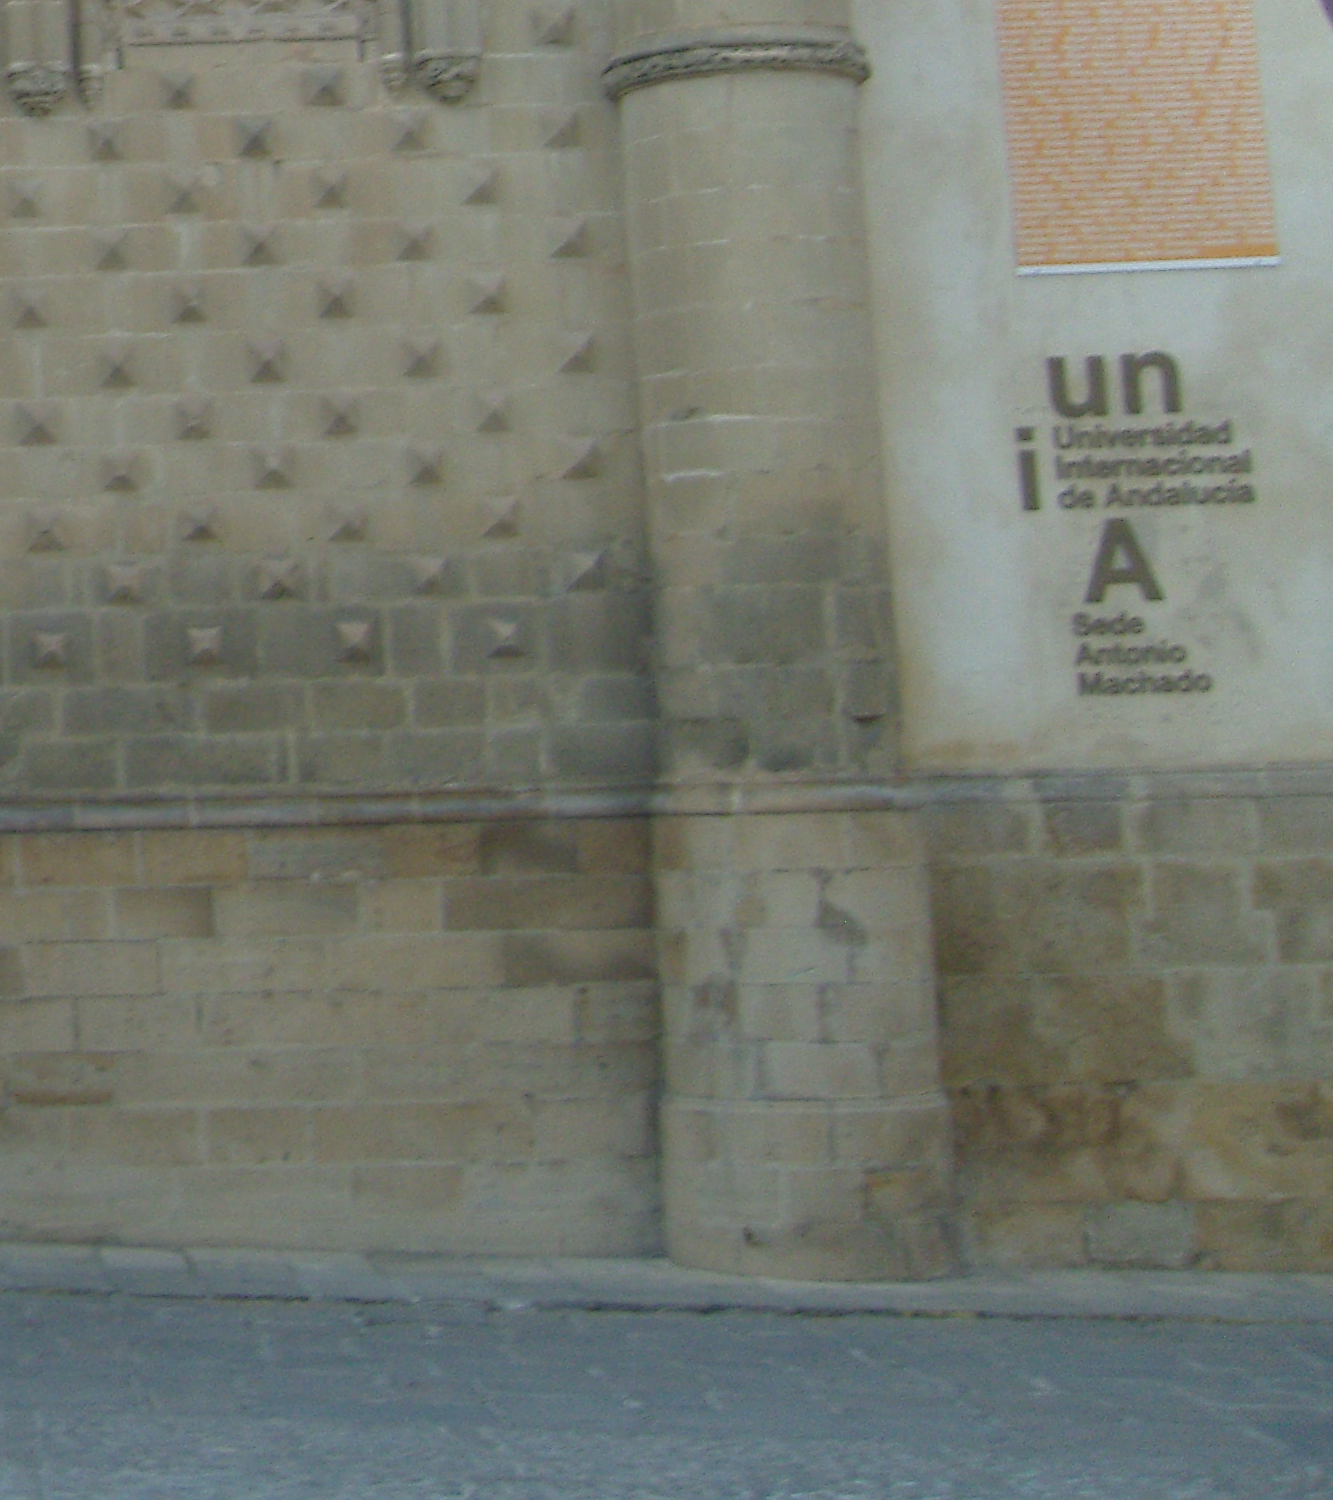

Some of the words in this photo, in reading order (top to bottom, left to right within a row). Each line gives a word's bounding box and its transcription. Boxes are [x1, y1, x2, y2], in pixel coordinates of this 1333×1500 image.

[1046, 351, 1183, 417] un
[1053, 420, 1232, 449] Universidad
[1014, 426, 1040, 510] i
[1055, 449, 1253, 479] Internacional
[1057, 483, 1095, 509] de
[1105, 479, 1255, 506] Andalucía
[1084, 518, 1164, 603] A
[1072, 611, 1145, 636] Sede
[1074, 639, 1187, 666] Antonio
[1077, 669, 1214, 695] Machado
